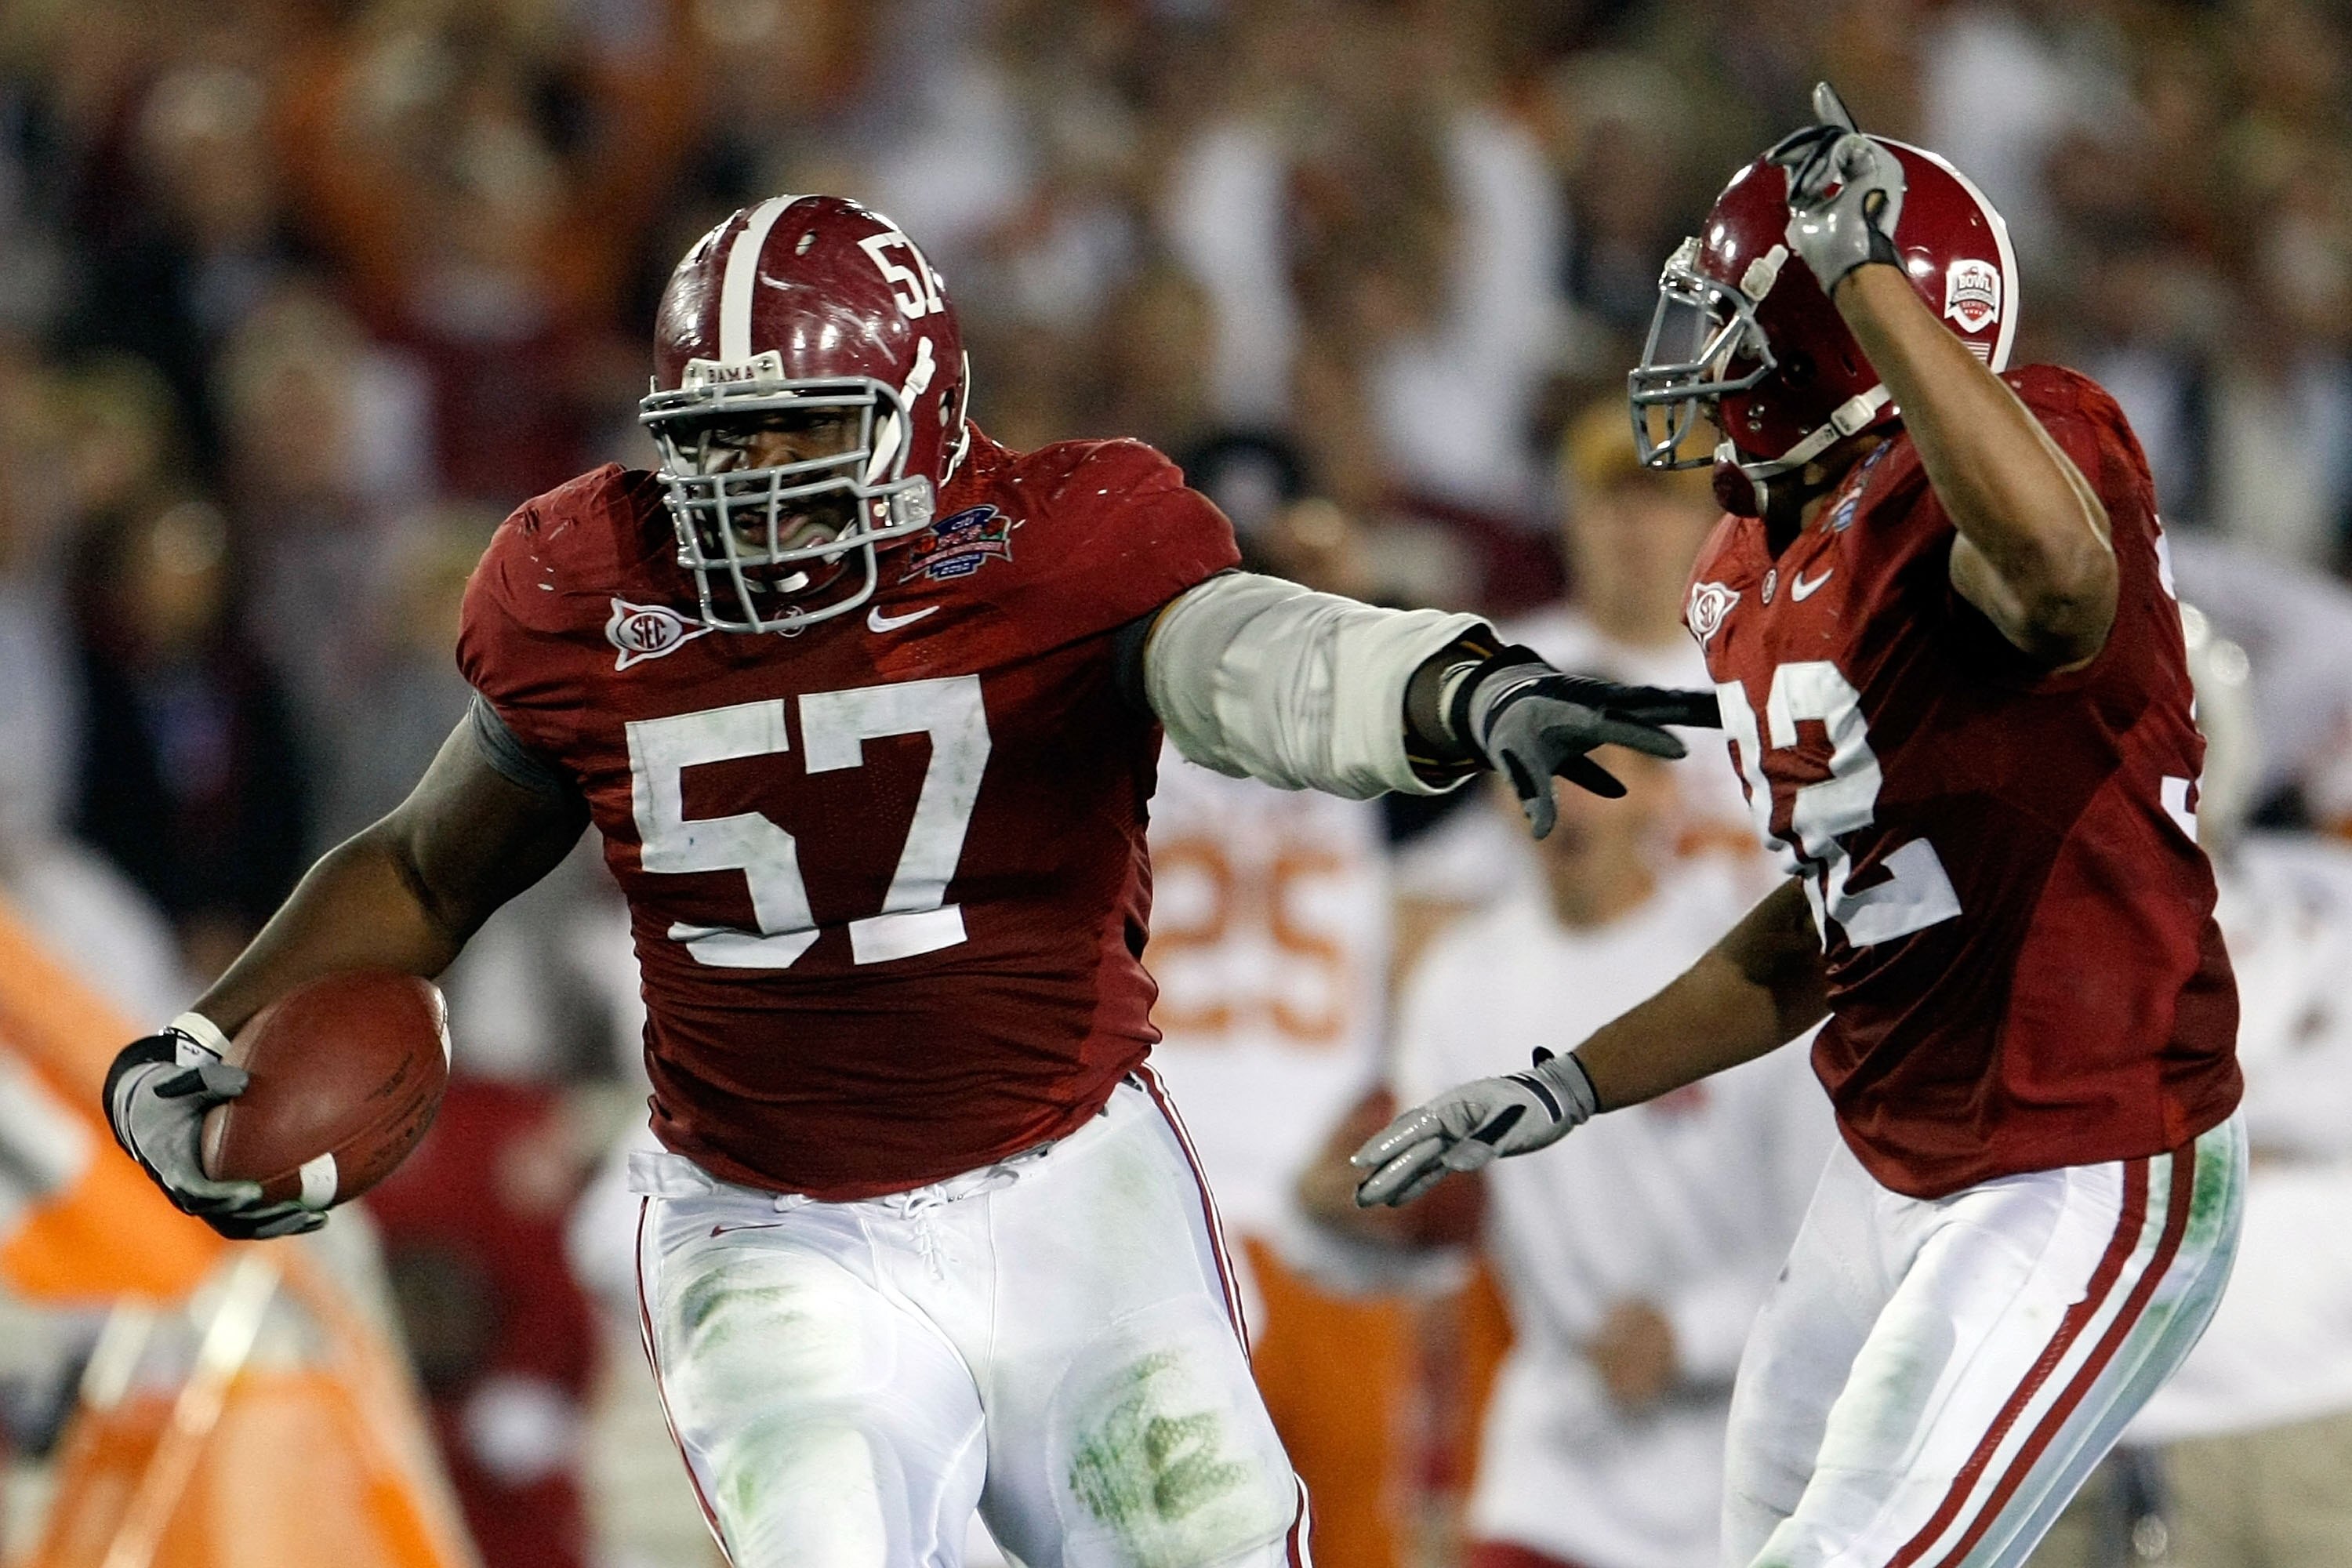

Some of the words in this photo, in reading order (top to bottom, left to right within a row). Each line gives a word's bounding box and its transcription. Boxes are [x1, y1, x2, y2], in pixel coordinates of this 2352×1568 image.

[857, 230, 944, 320] 57
[1958, 273, 1992, 292] BOWL
[707, 365, 755, 384] BAMA
[631, 615, 667, 649] SEC
[625, 674, 993, 969] 57
